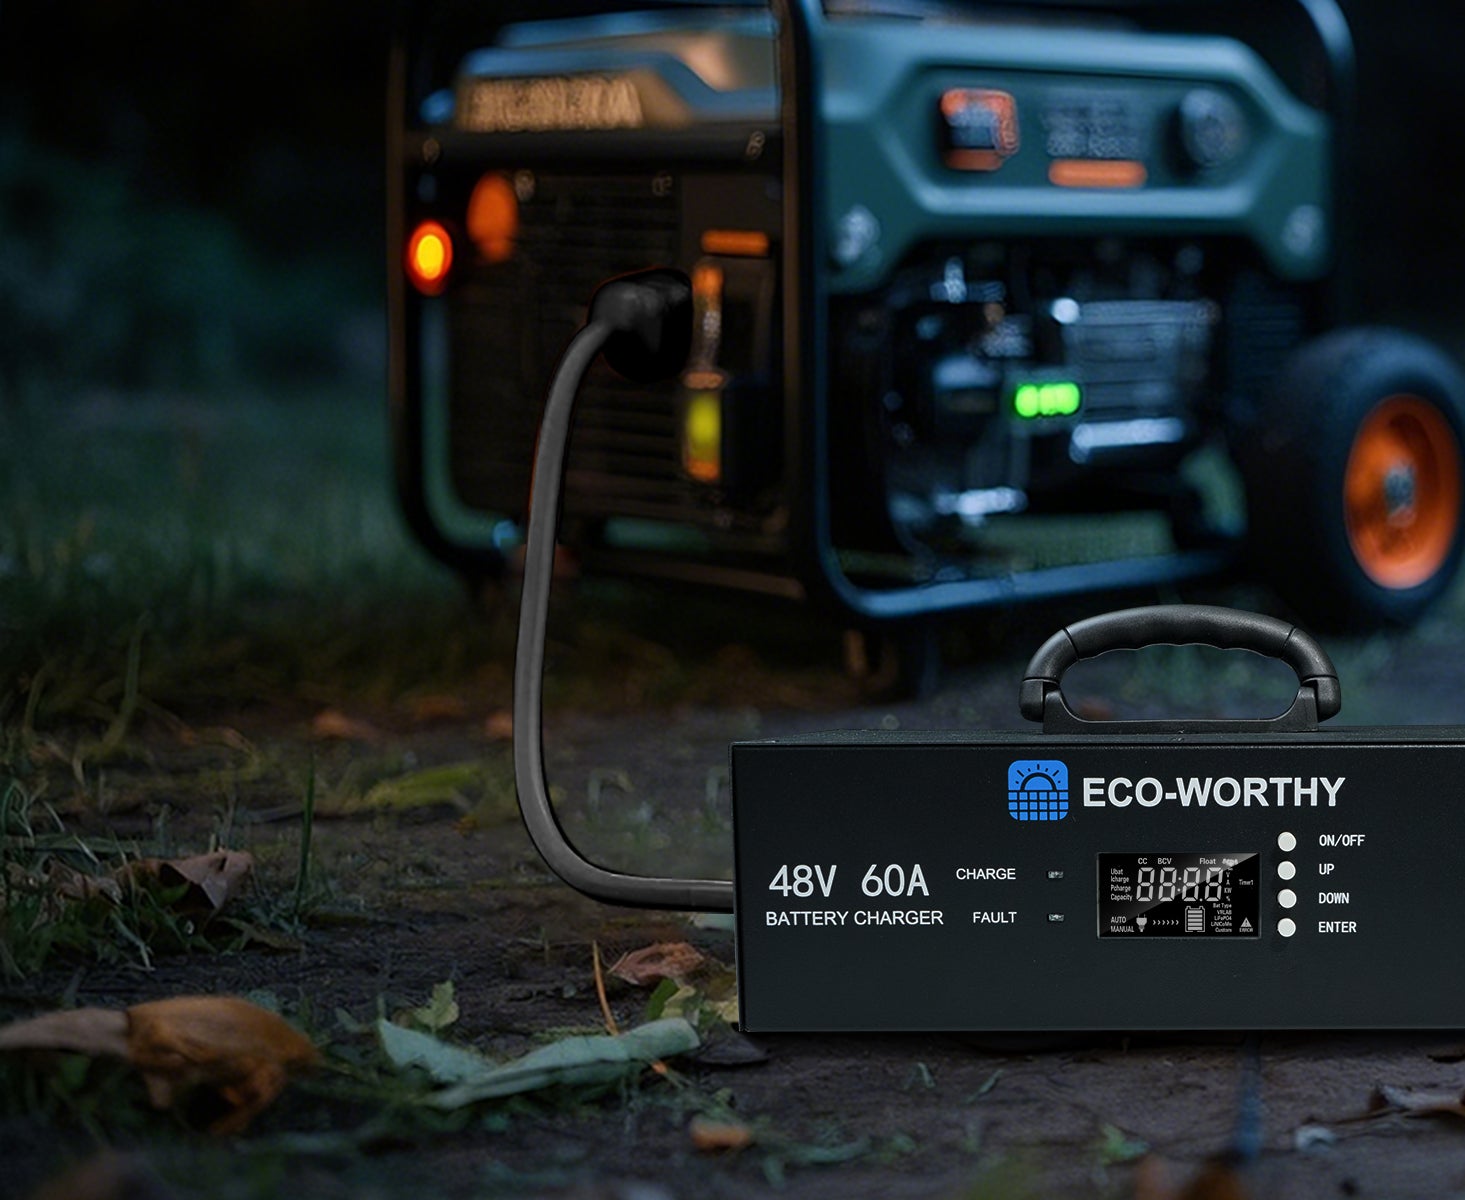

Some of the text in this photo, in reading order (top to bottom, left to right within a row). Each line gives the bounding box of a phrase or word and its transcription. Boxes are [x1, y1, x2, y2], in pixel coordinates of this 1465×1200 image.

[1083, 776, 1346, 808] ECO-WORTHY
[1318, 833, 1366, 847] ON/OFF
[1137, 857, 1148, 865] CC
[1199, 857, 1217, 865] Float
[956, 867, 1017, 880] CHARGE
[1318, 863, 1336, 875] UP
[768, 863, 930, 898] 48V 60A
[1110, 893, 1133, 901] Capacity
[1318, 892, 1351, 904] DOWN
[766, 910, 944, 926] BATTERY CHARGER
[973, 911, 1018, 924] FAULT
[1110, 916, 1127, 924] AUTO
[1110, 925, 1135, 933] MANUAL
[1318, 921, 1358, 934] ENTER
